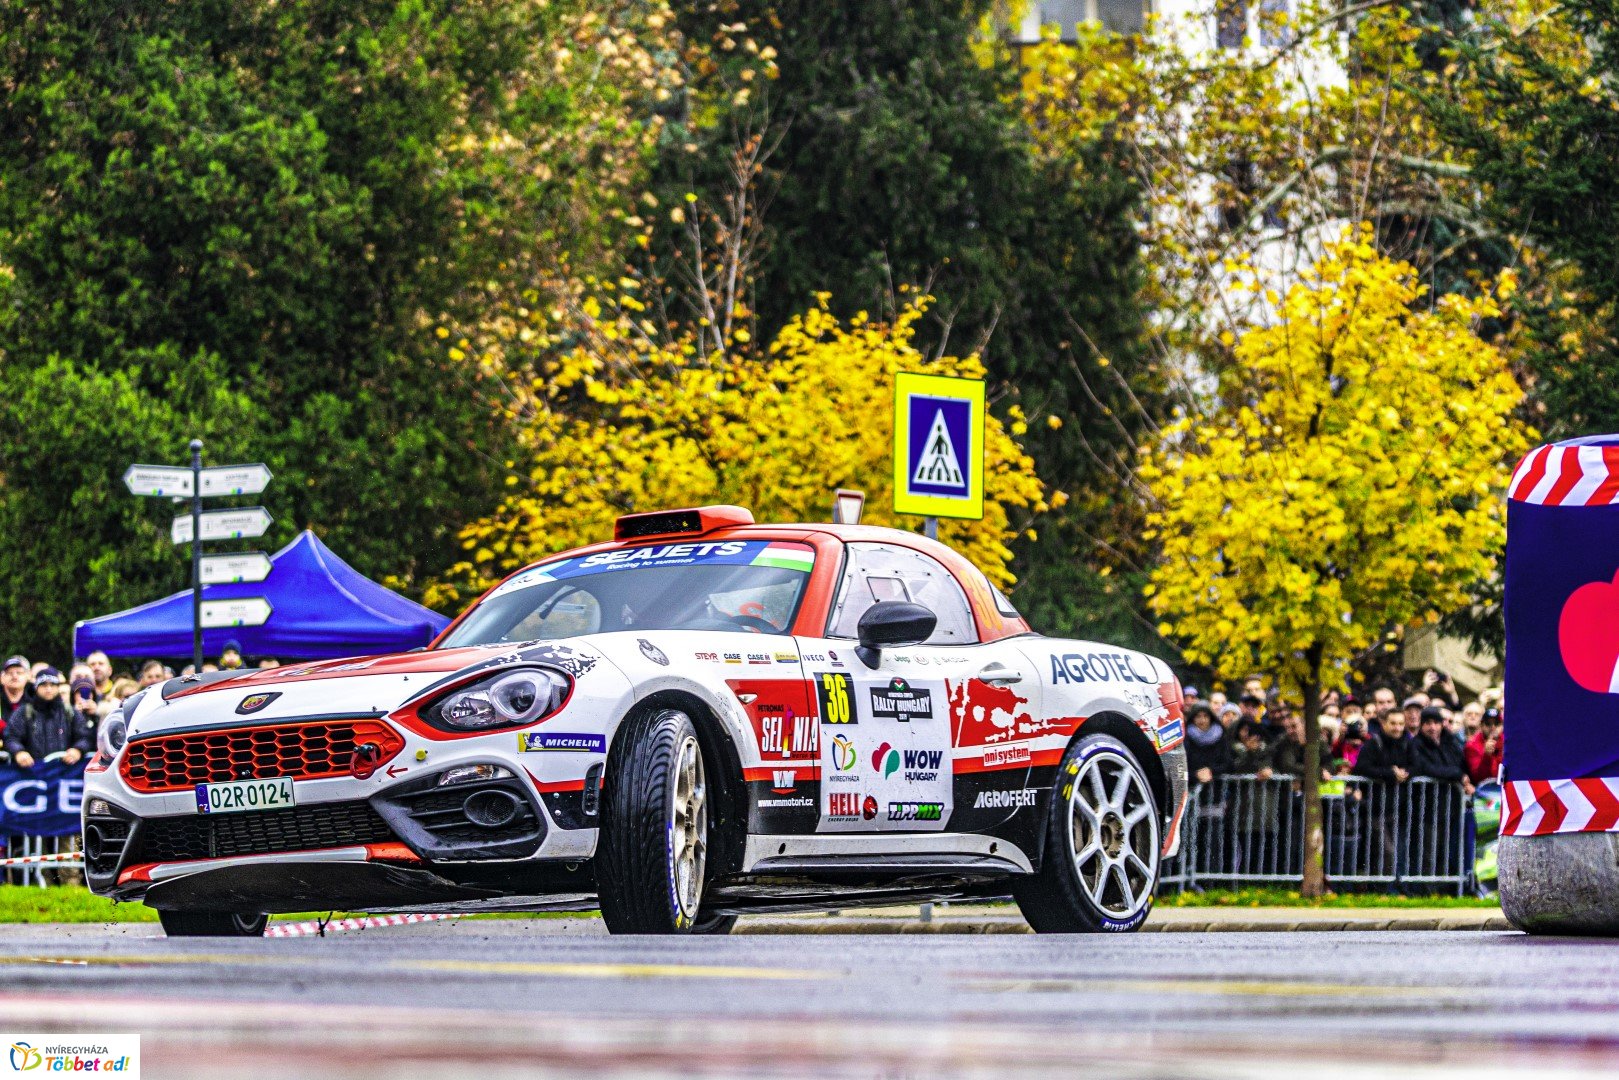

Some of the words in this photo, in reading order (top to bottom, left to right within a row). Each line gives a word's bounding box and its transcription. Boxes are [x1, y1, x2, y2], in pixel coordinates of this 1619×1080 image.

[579, 541, 747, 568] SEAJETS
[606, 562, 641, 570] Racing
[695, 652, 718, 661] STEYR
[747, 653, 765, 661] CASE
[802, 654, 825, 662] IVECO
[1050, 653, 1148, 685] AGROTEC
[822, 673, 850, 724] 36
[872, 694, 896, 712] RALLY
[896, 695, 930, 713] HUNGARY
[545, 738, 600, 748] MICHELIN
[904, 749, 943, 769] WOW
[904, 771, 938, 781] HUNGARY
[757, 796, 814, 808] www.vmmotori.cz
[829, 793, 860, 816] HELL
[974, 789, 1037, 808] AGROFERT
